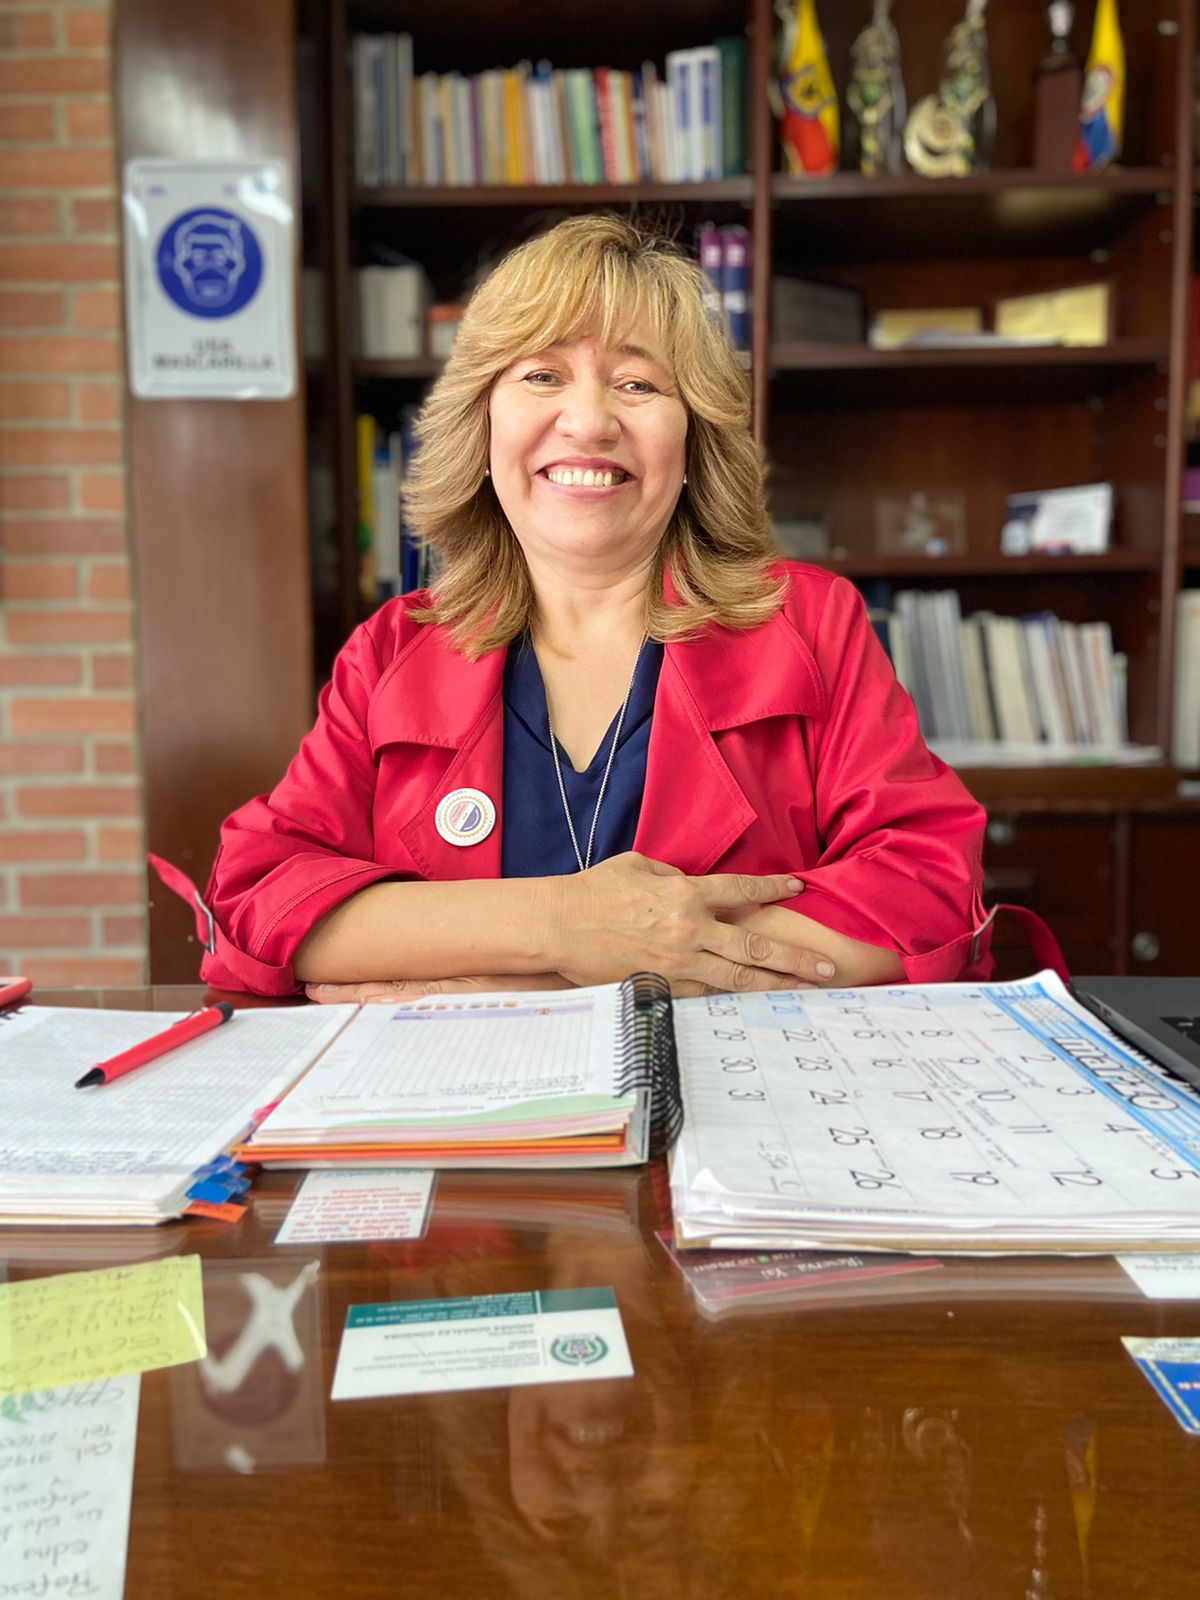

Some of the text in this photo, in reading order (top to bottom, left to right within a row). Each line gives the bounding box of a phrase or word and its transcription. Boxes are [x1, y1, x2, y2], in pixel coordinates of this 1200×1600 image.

[781, 1028, 818, 1042] 22
[720, 1056, 757, 1074] 30
[794, 1055, 833, 1072] 23
[1050, 1036, 1180, 1111] marzo
[728, 1088, 767, 1102] 31
[808, 1088, 851, 1106] 24
[974, 1088, 1017, 1101] 10
[827, 1126, 876, 1147] 25
[917, 1126, 963, 1140] 18
[848, 1168, 903, 1191] 26
[948, 1170, 1000, 1186] 19
[1049, 1170, 1103, 1187] 12
